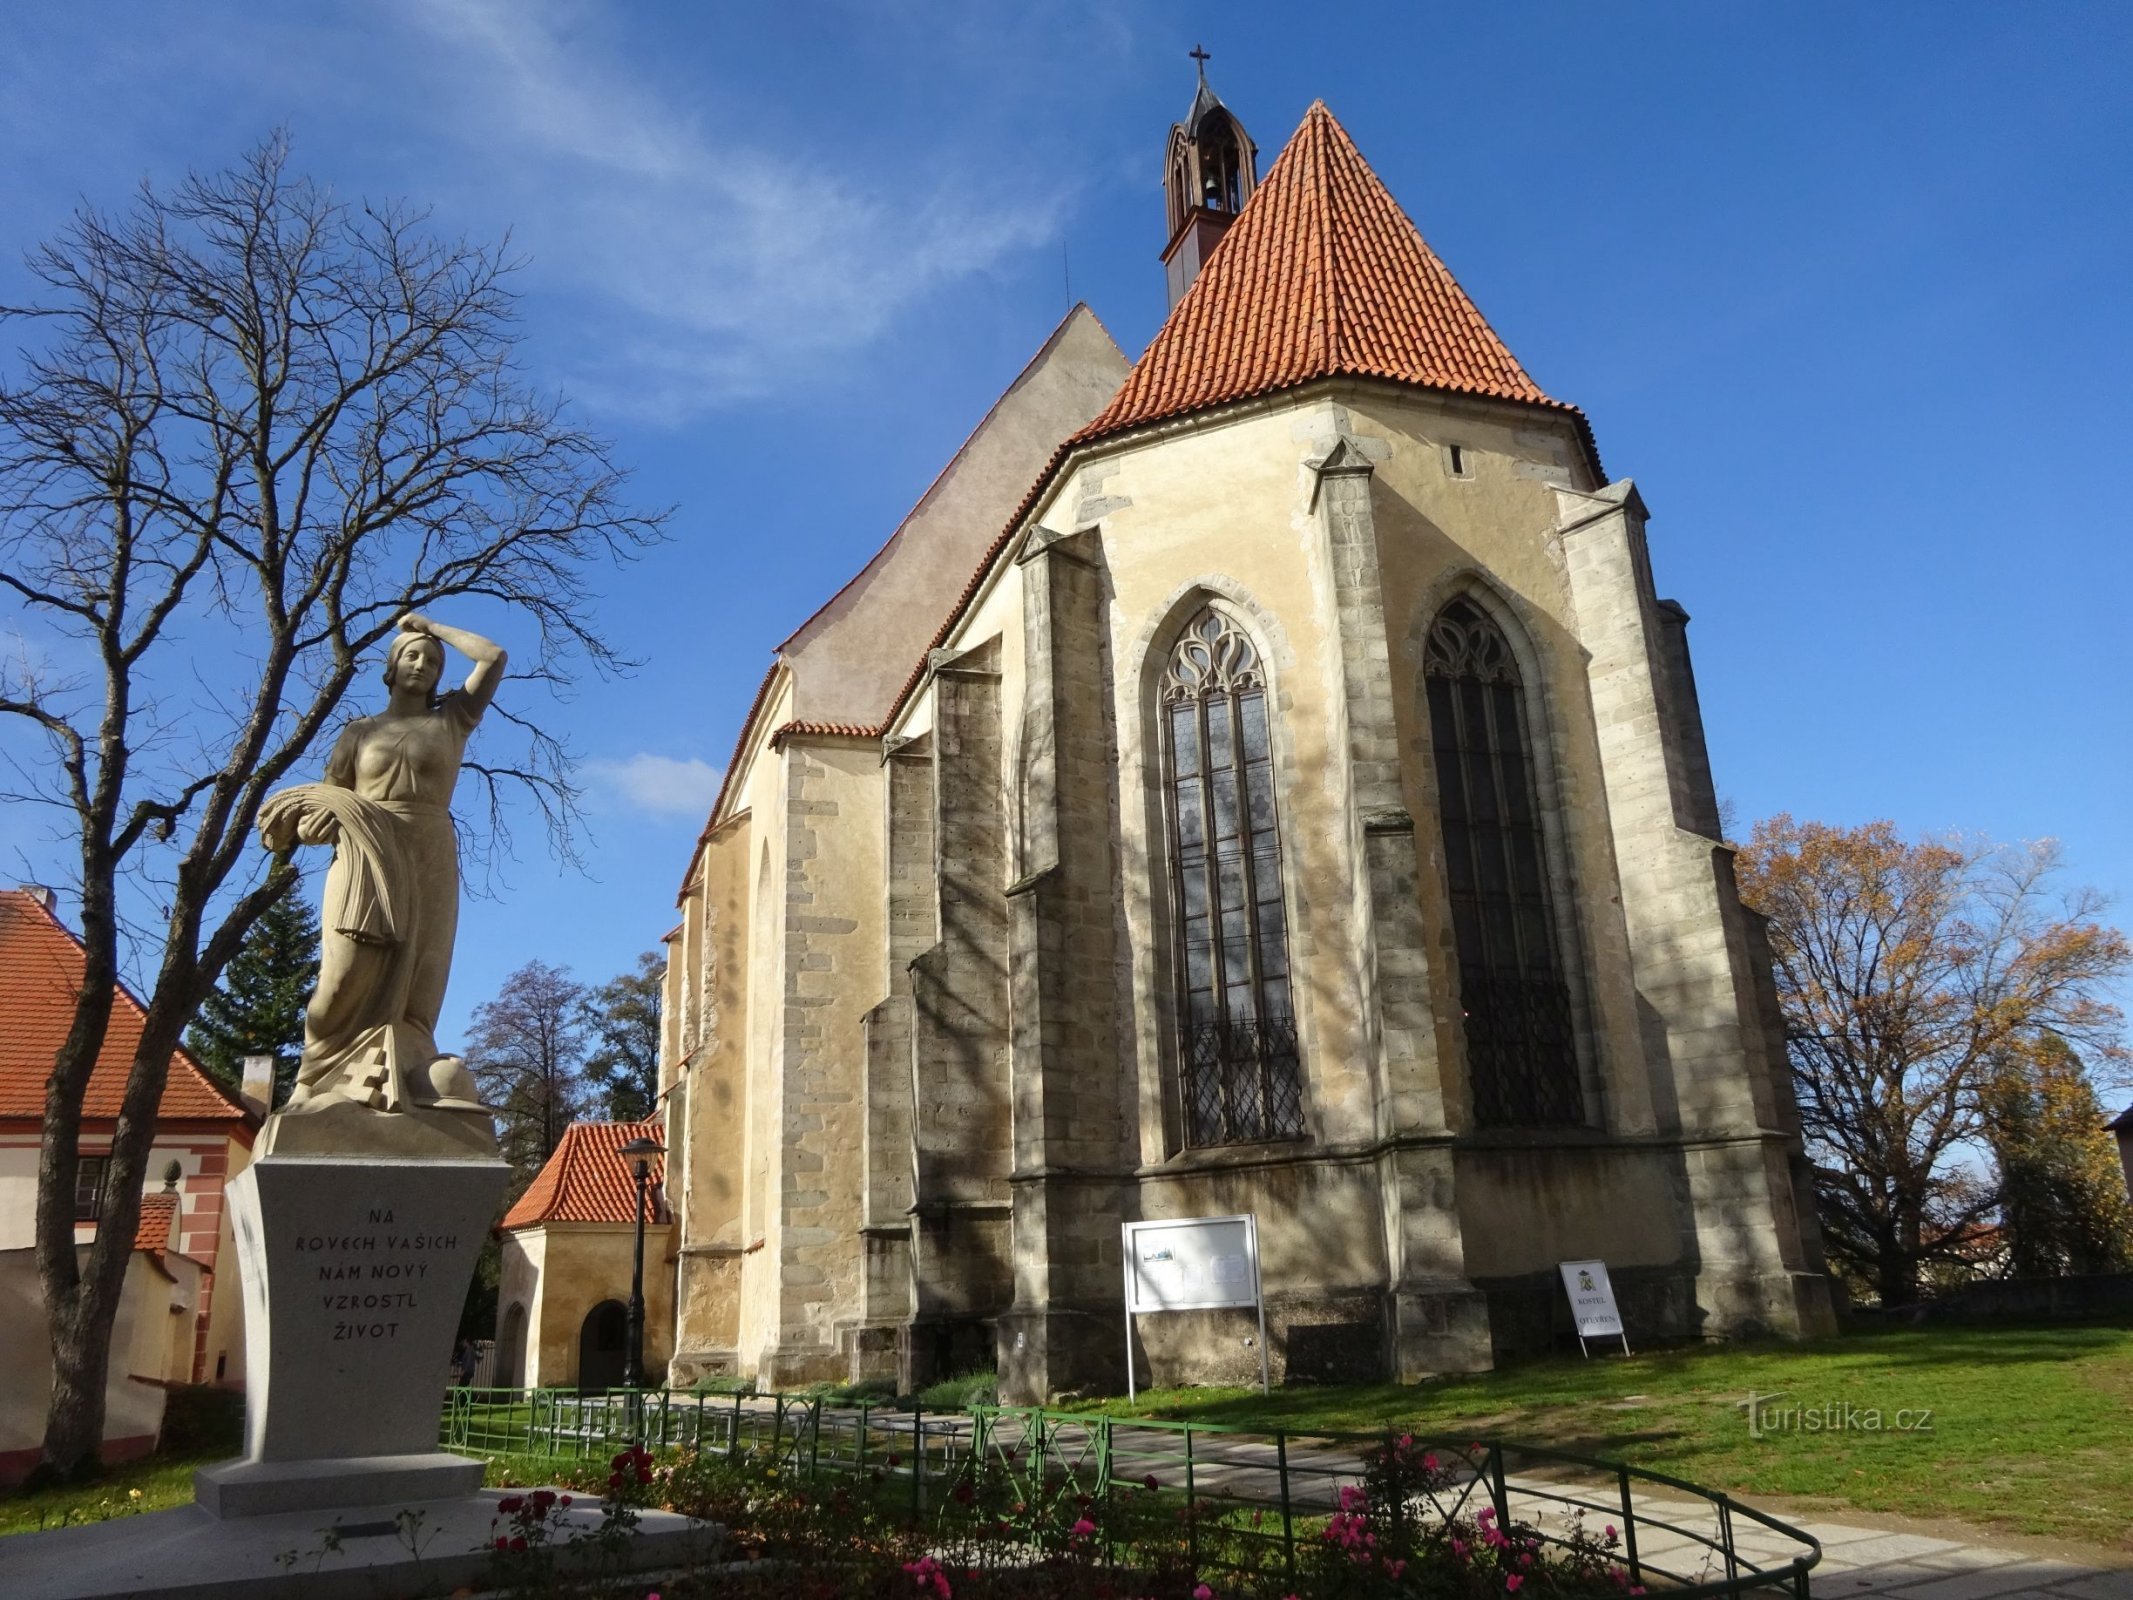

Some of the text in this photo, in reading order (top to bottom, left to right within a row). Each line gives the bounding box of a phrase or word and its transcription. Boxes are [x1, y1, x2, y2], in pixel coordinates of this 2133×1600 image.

[369, 1209, 394, 1223] NA
[296, 1233, 457, 1250] ROVECH VAŠICH
[320, 1261, 428, 1280] NÁM NOVÝ
[323, 1294, 417, 1310] VZROSTL
[334, 1321, 399, 1340] ŽIVOT
